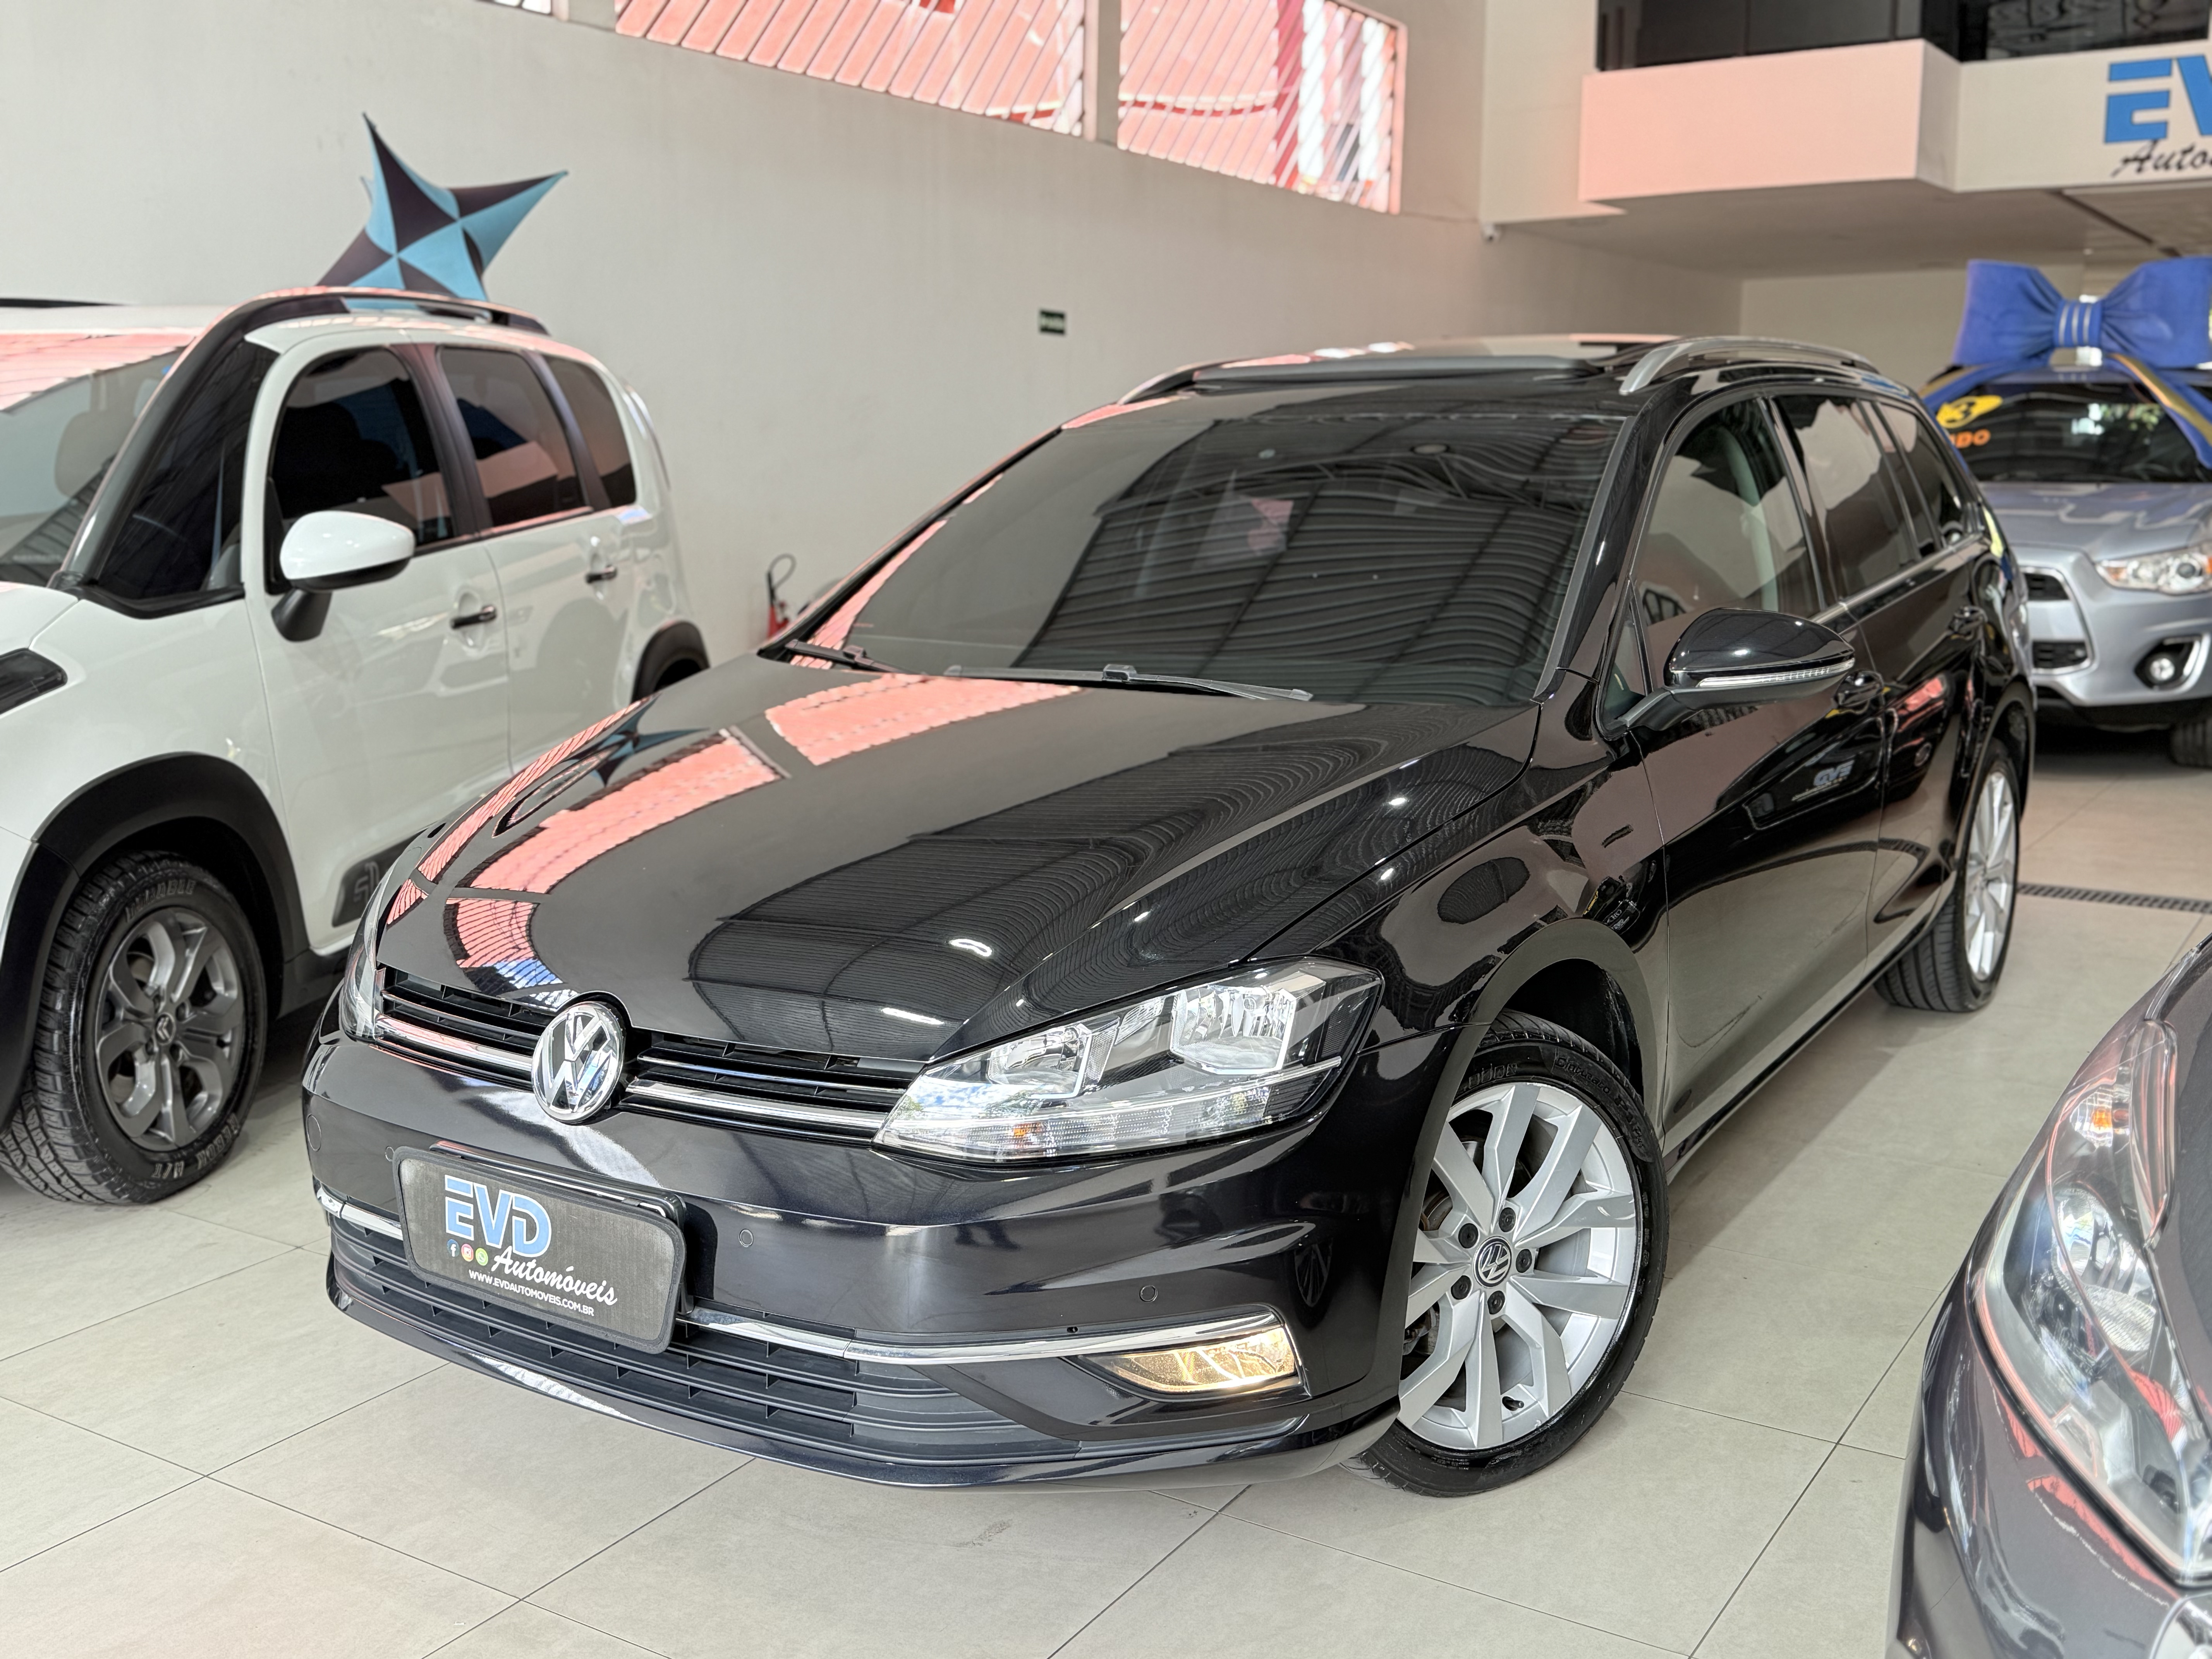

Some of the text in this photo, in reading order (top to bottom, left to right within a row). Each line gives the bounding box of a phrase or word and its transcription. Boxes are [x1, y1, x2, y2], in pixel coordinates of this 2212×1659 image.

[2110, 139, 2212, 178] Auto
[445, 1175, 552, 1258] EVD
[469, 1269, 594, 1316] WWW.EVDAUTOMOVEIS.COM.BR
[491, 1245, 618, 1305] Automóveis
